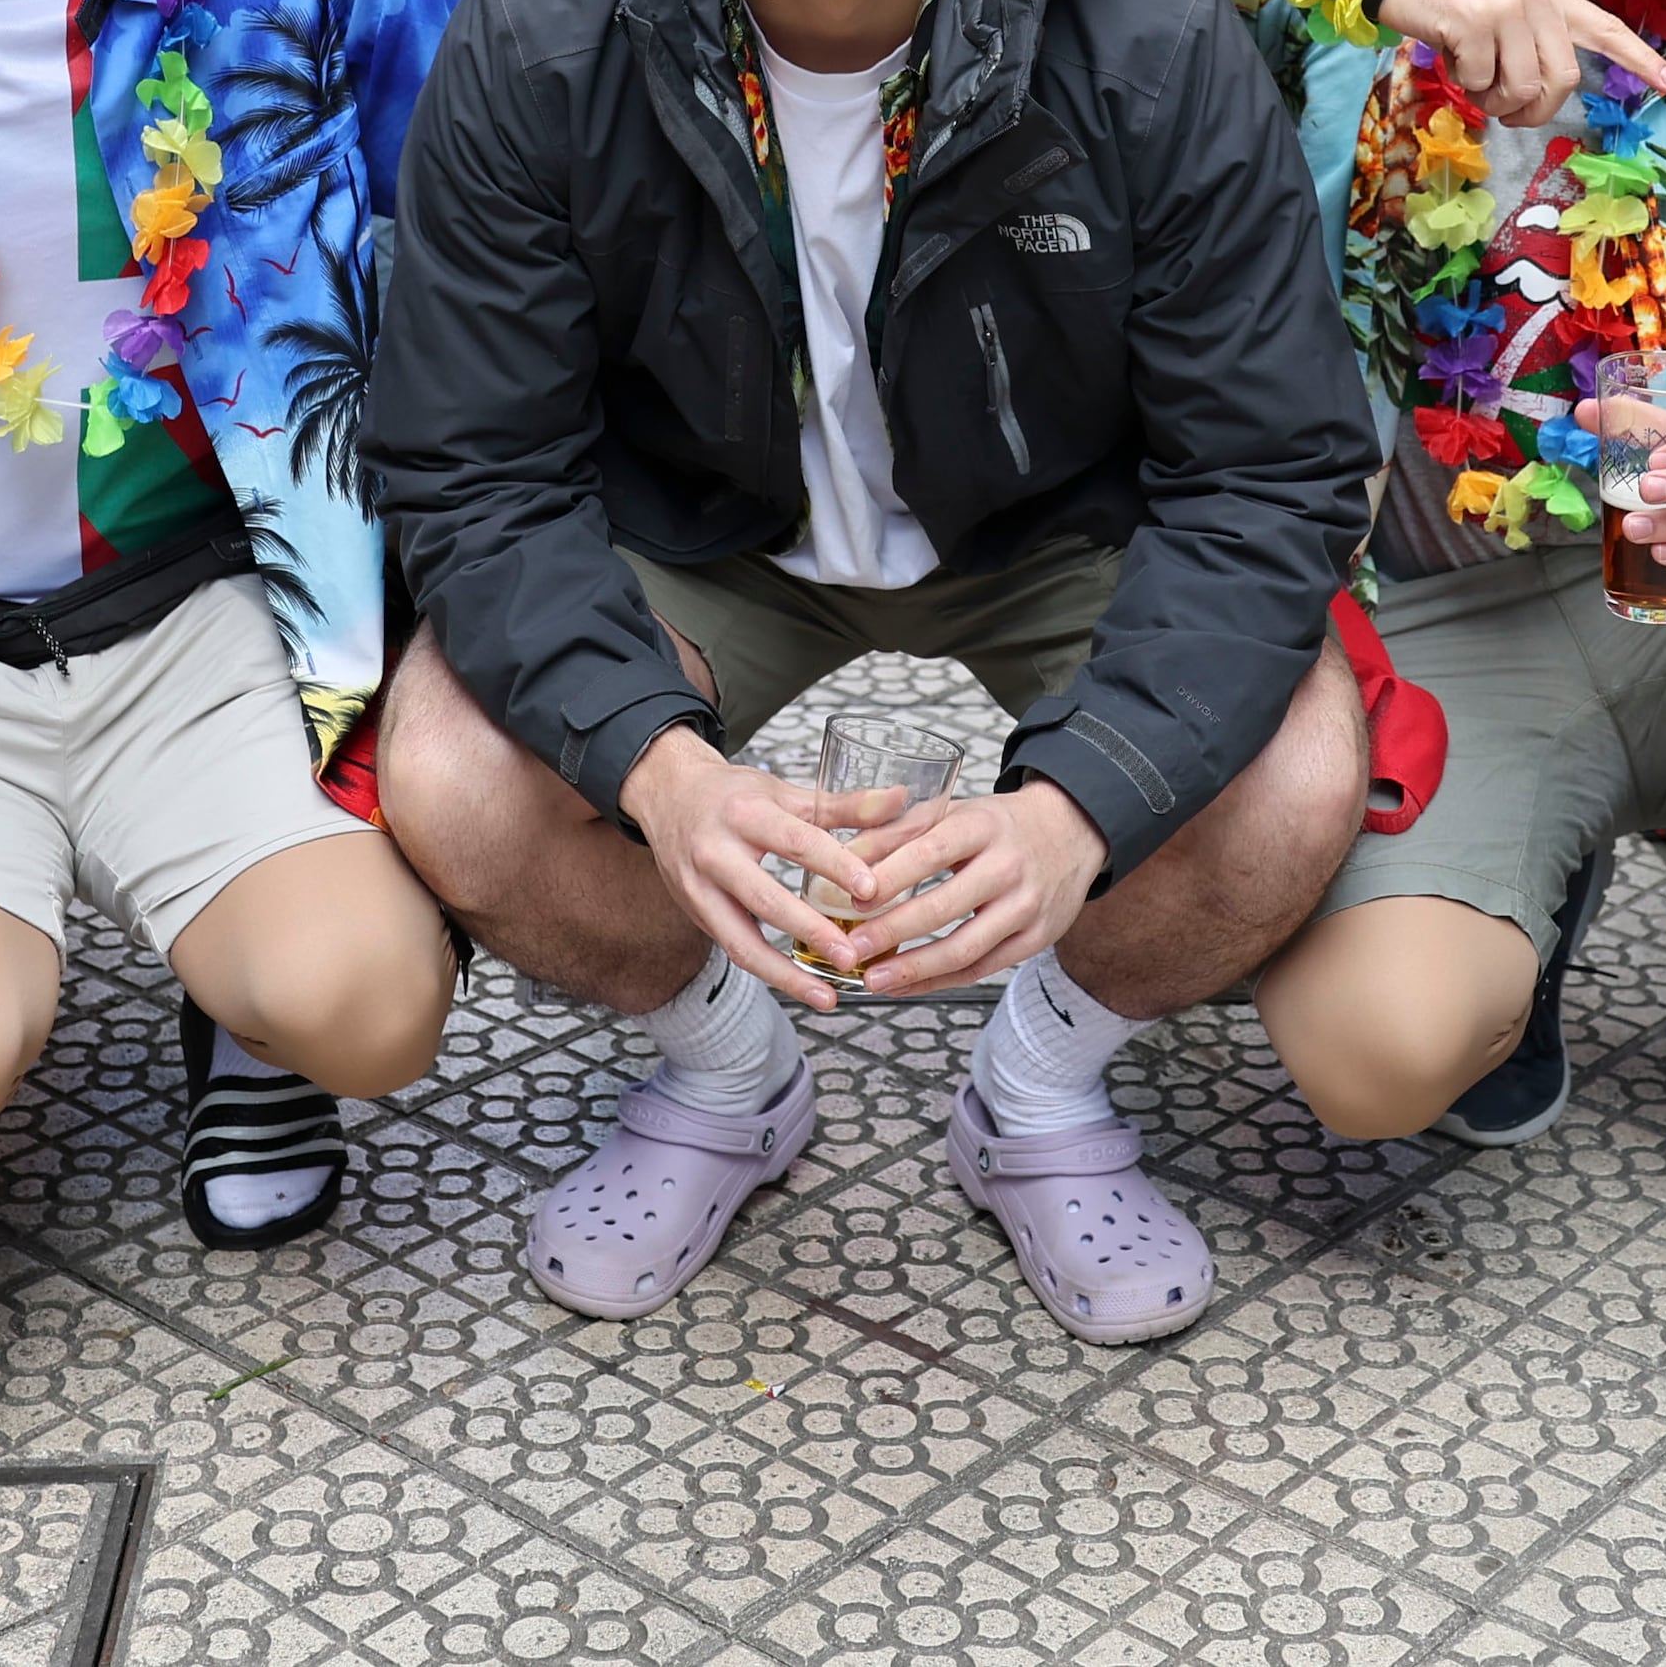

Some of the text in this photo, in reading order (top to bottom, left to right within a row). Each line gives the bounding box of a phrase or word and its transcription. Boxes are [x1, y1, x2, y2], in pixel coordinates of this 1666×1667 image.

[1019, 214, 1055, 228] THE
[997, 224, 1057, 242] NORTH
[1015, 239, 1059, 254] FACE
